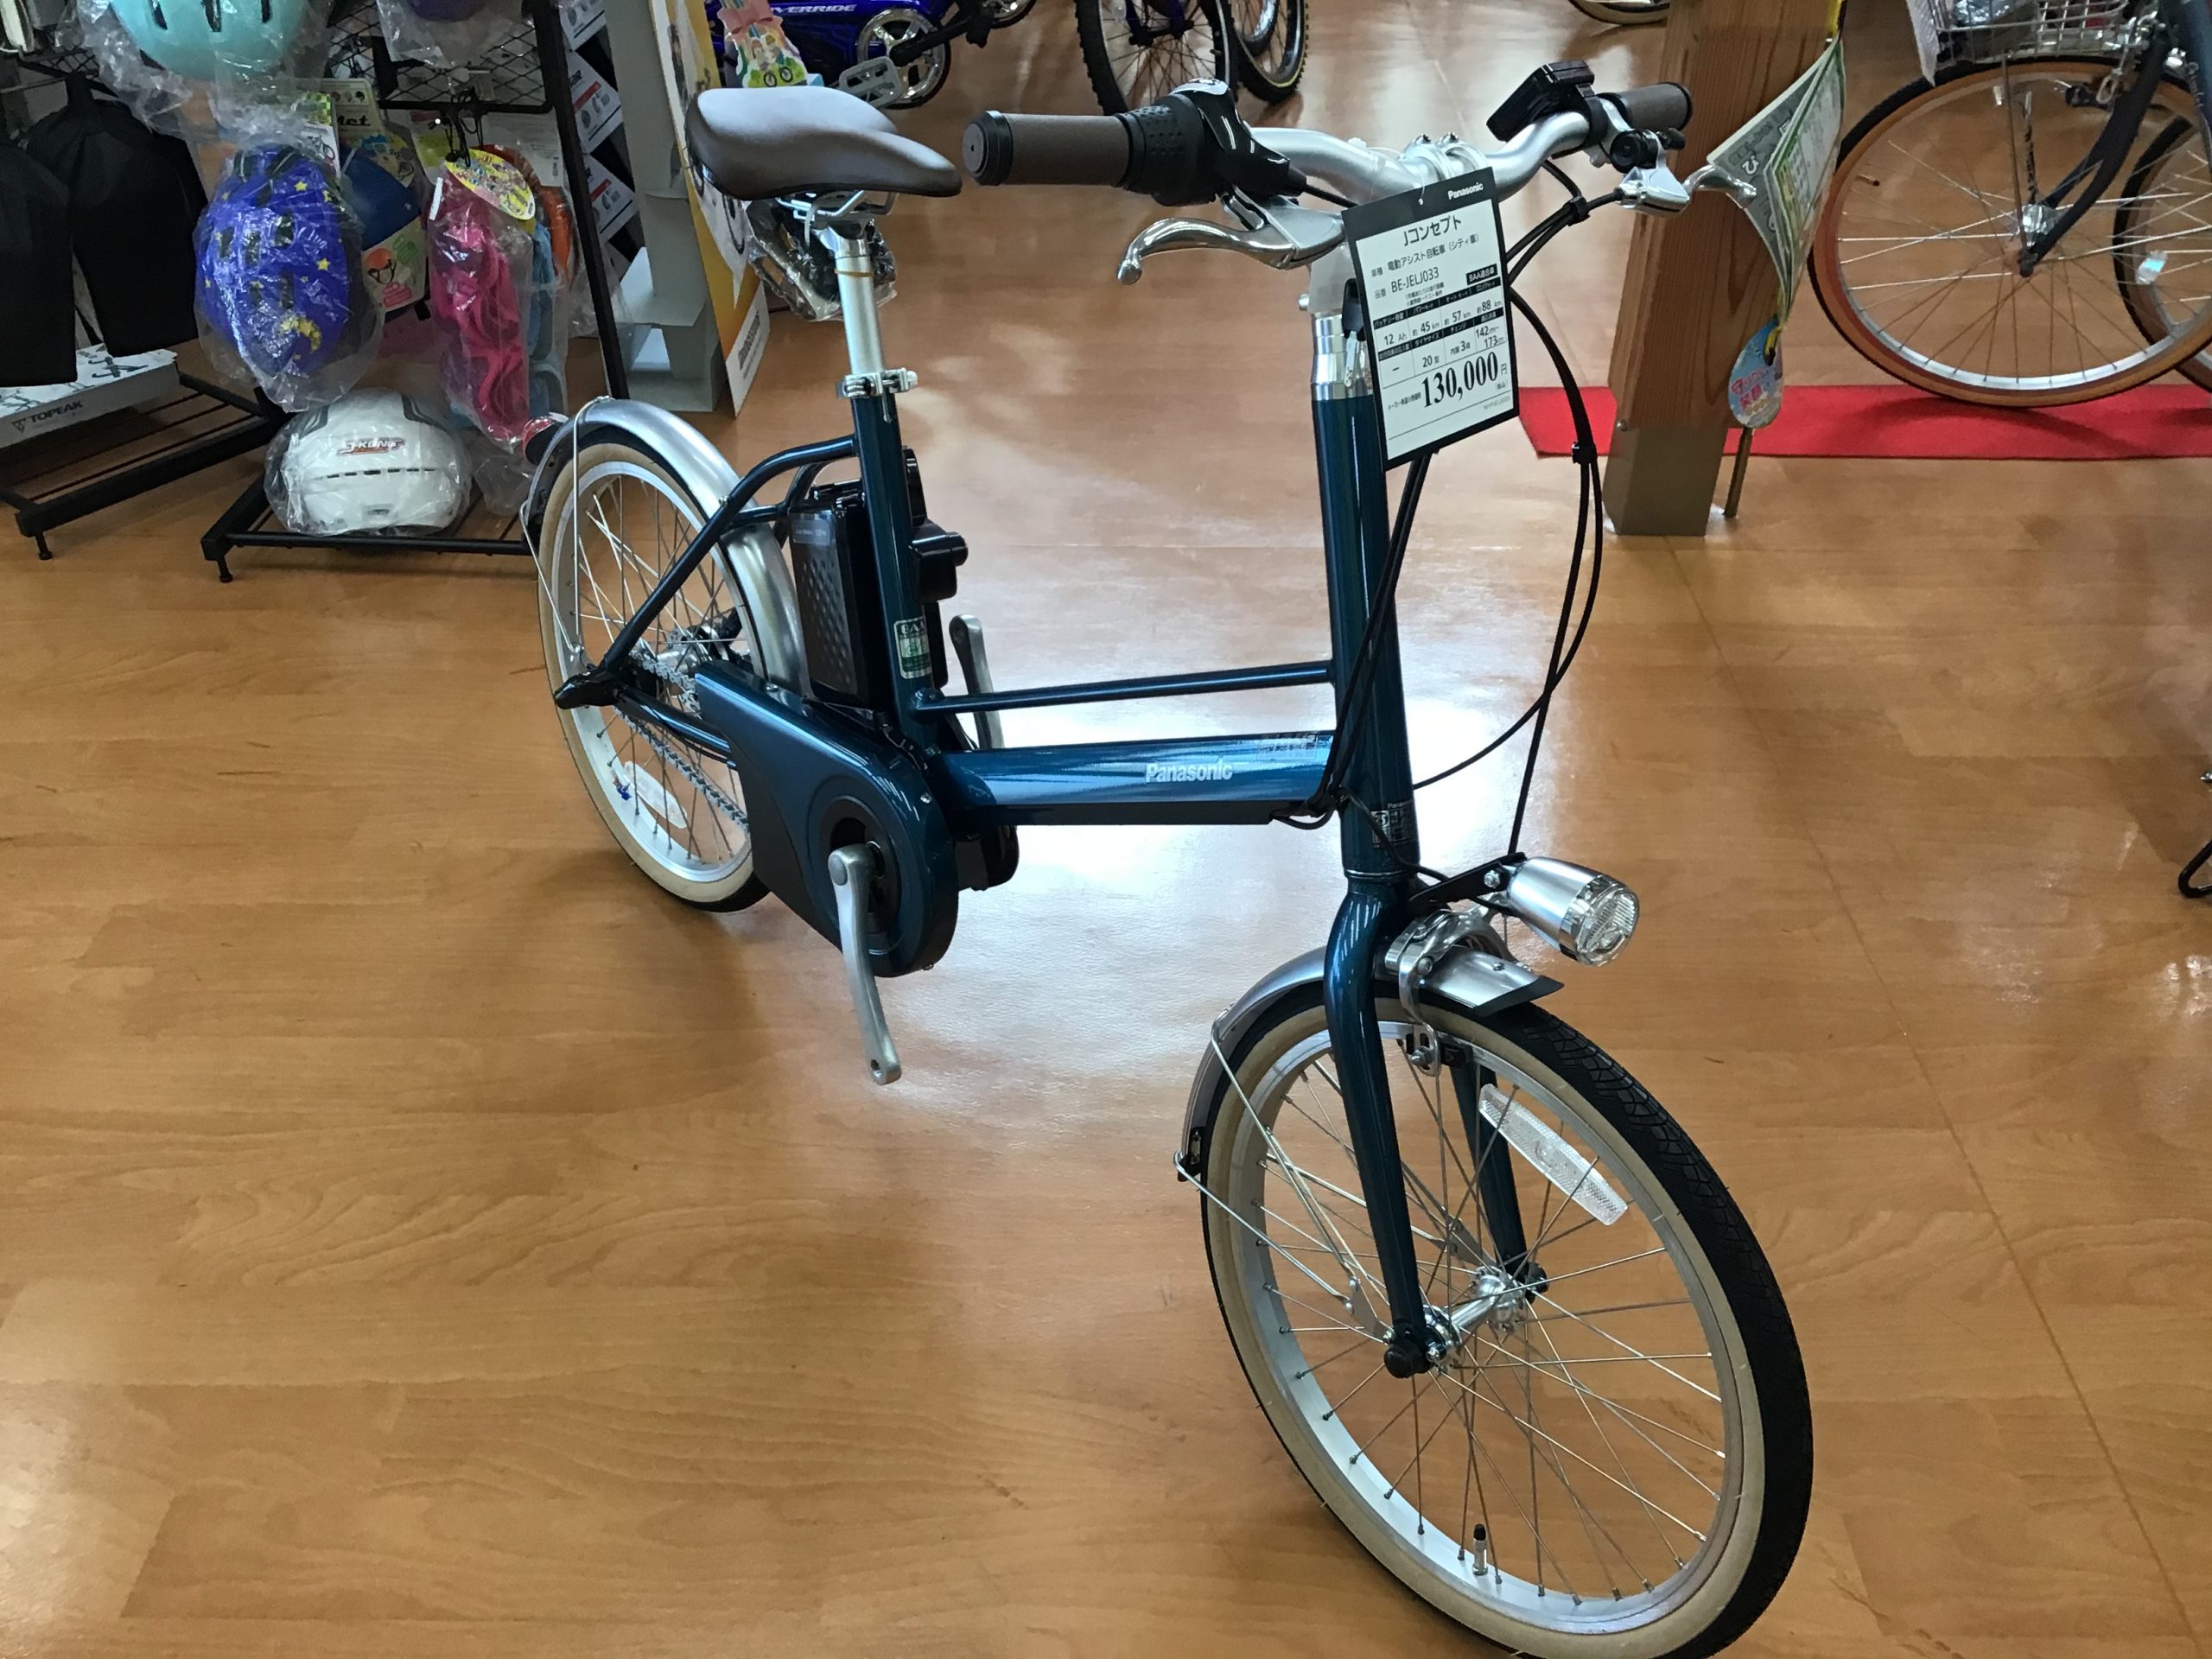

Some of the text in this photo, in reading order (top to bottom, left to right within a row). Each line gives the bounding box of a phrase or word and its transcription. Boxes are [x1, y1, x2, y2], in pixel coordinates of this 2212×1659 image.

[772, 4, 857, 13] VERRIDE
[1447, 181, 1484, 200] Panasonic
[1404, 215, 1461, 246] Jコンセプト
[1391, 266, 1440, 293] BE-JELJ033
[1452, 310, 1461, 322] 57
[1420, 321, 1430, 333] 45
[1383, 331, 1407, 346] 12 Ah
[1421, 354, 1432, 367] 20
[1421, 351, 1498, 408] 130,000
[30, 400, 84, 423] TOPEAK
[1146, 760, 1234, 783] Panasonic
